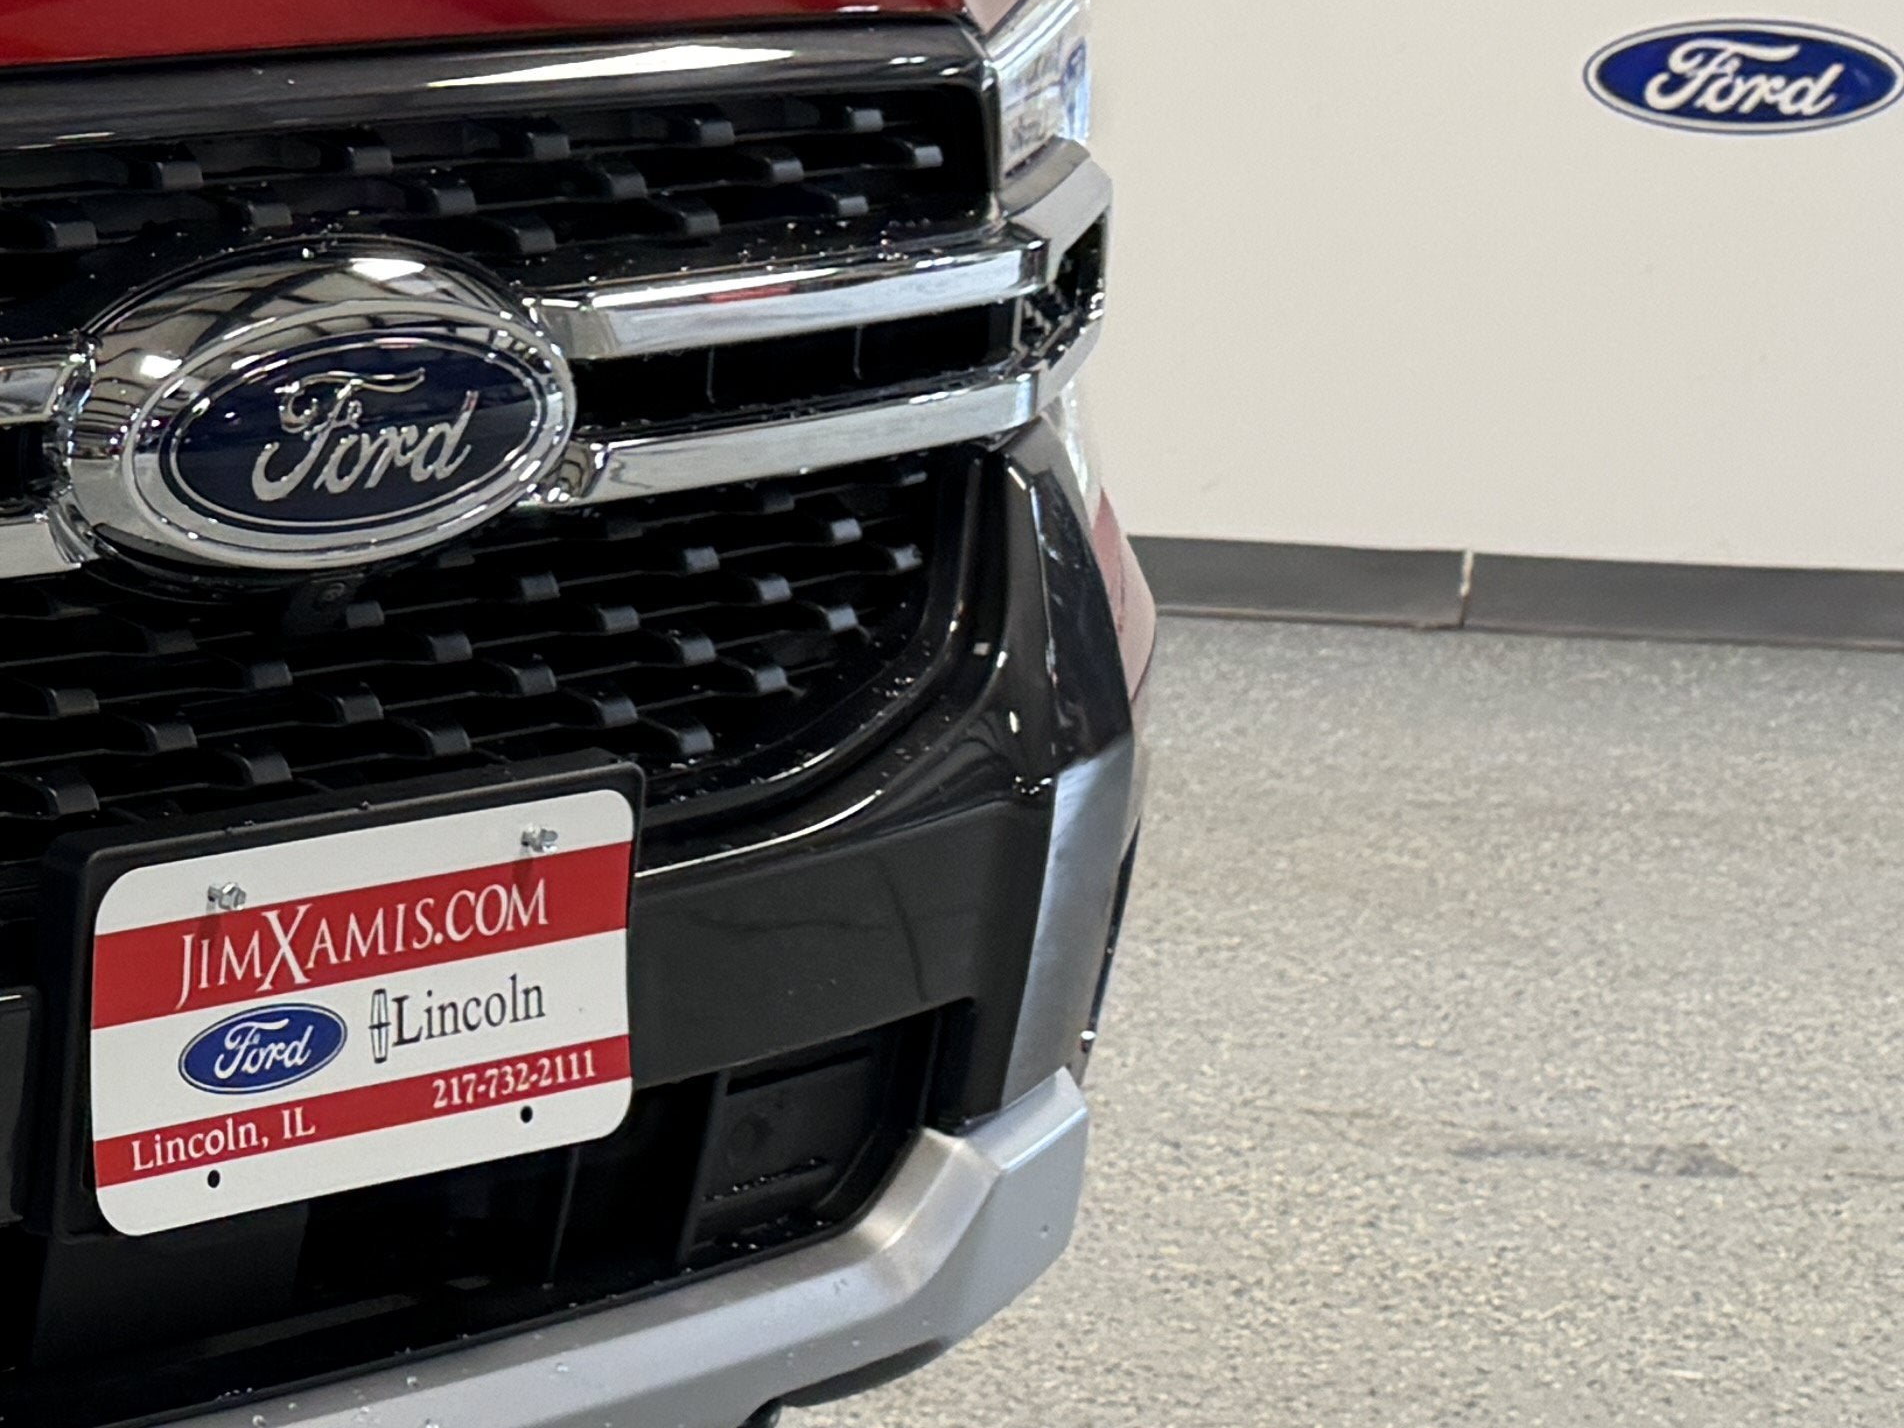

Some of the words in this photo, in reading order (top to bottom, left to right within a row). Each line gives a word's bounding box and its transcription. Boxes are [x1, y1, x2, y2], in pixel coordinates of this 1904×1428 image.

[1644, 38, 1845, 116] Ford
[251, 368, 480, 502] Ford
[176, 878, 550, 1010] JIMXAMIS.COM
[391, 974, 547, 1048] Lincoln
[213, 1018, 314, 1079] Ford
[431, 1048, 597, 1110] 217-732-2111
[130, 1117, 270, 1172] Lincoln,
[279, 1106, 317, 1141] IL
